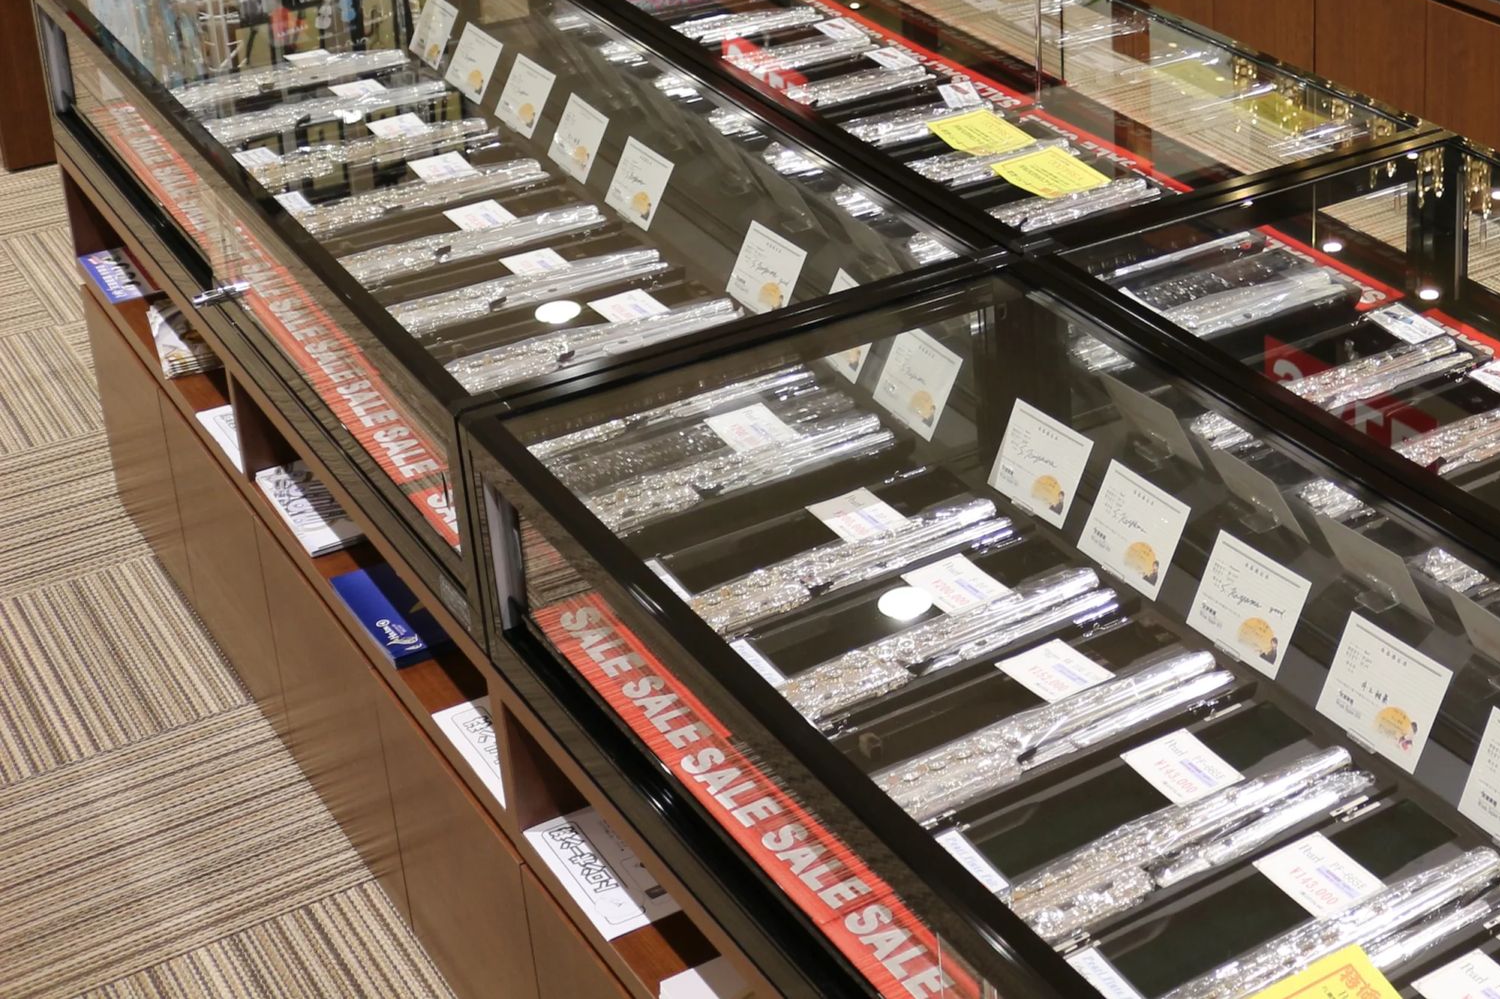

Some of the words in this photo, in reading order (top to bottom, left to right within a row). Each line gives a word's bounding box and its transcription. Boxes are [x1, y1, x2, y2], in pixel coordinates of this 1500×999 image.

[305, 340, 366, 383] SALE
[336, 379, 398, 428] SALE
[373, 426, 440, 478] SALE
[560, 606, 645, 678] SALE
[622, 675, 713, 749] SALE
[680, 747, 783, 828] SALE
[762, 823, 873, 910] SALE
[845, 904, 958, 999] SALE
[1289, 866, 1338, 905] ¥143,000
